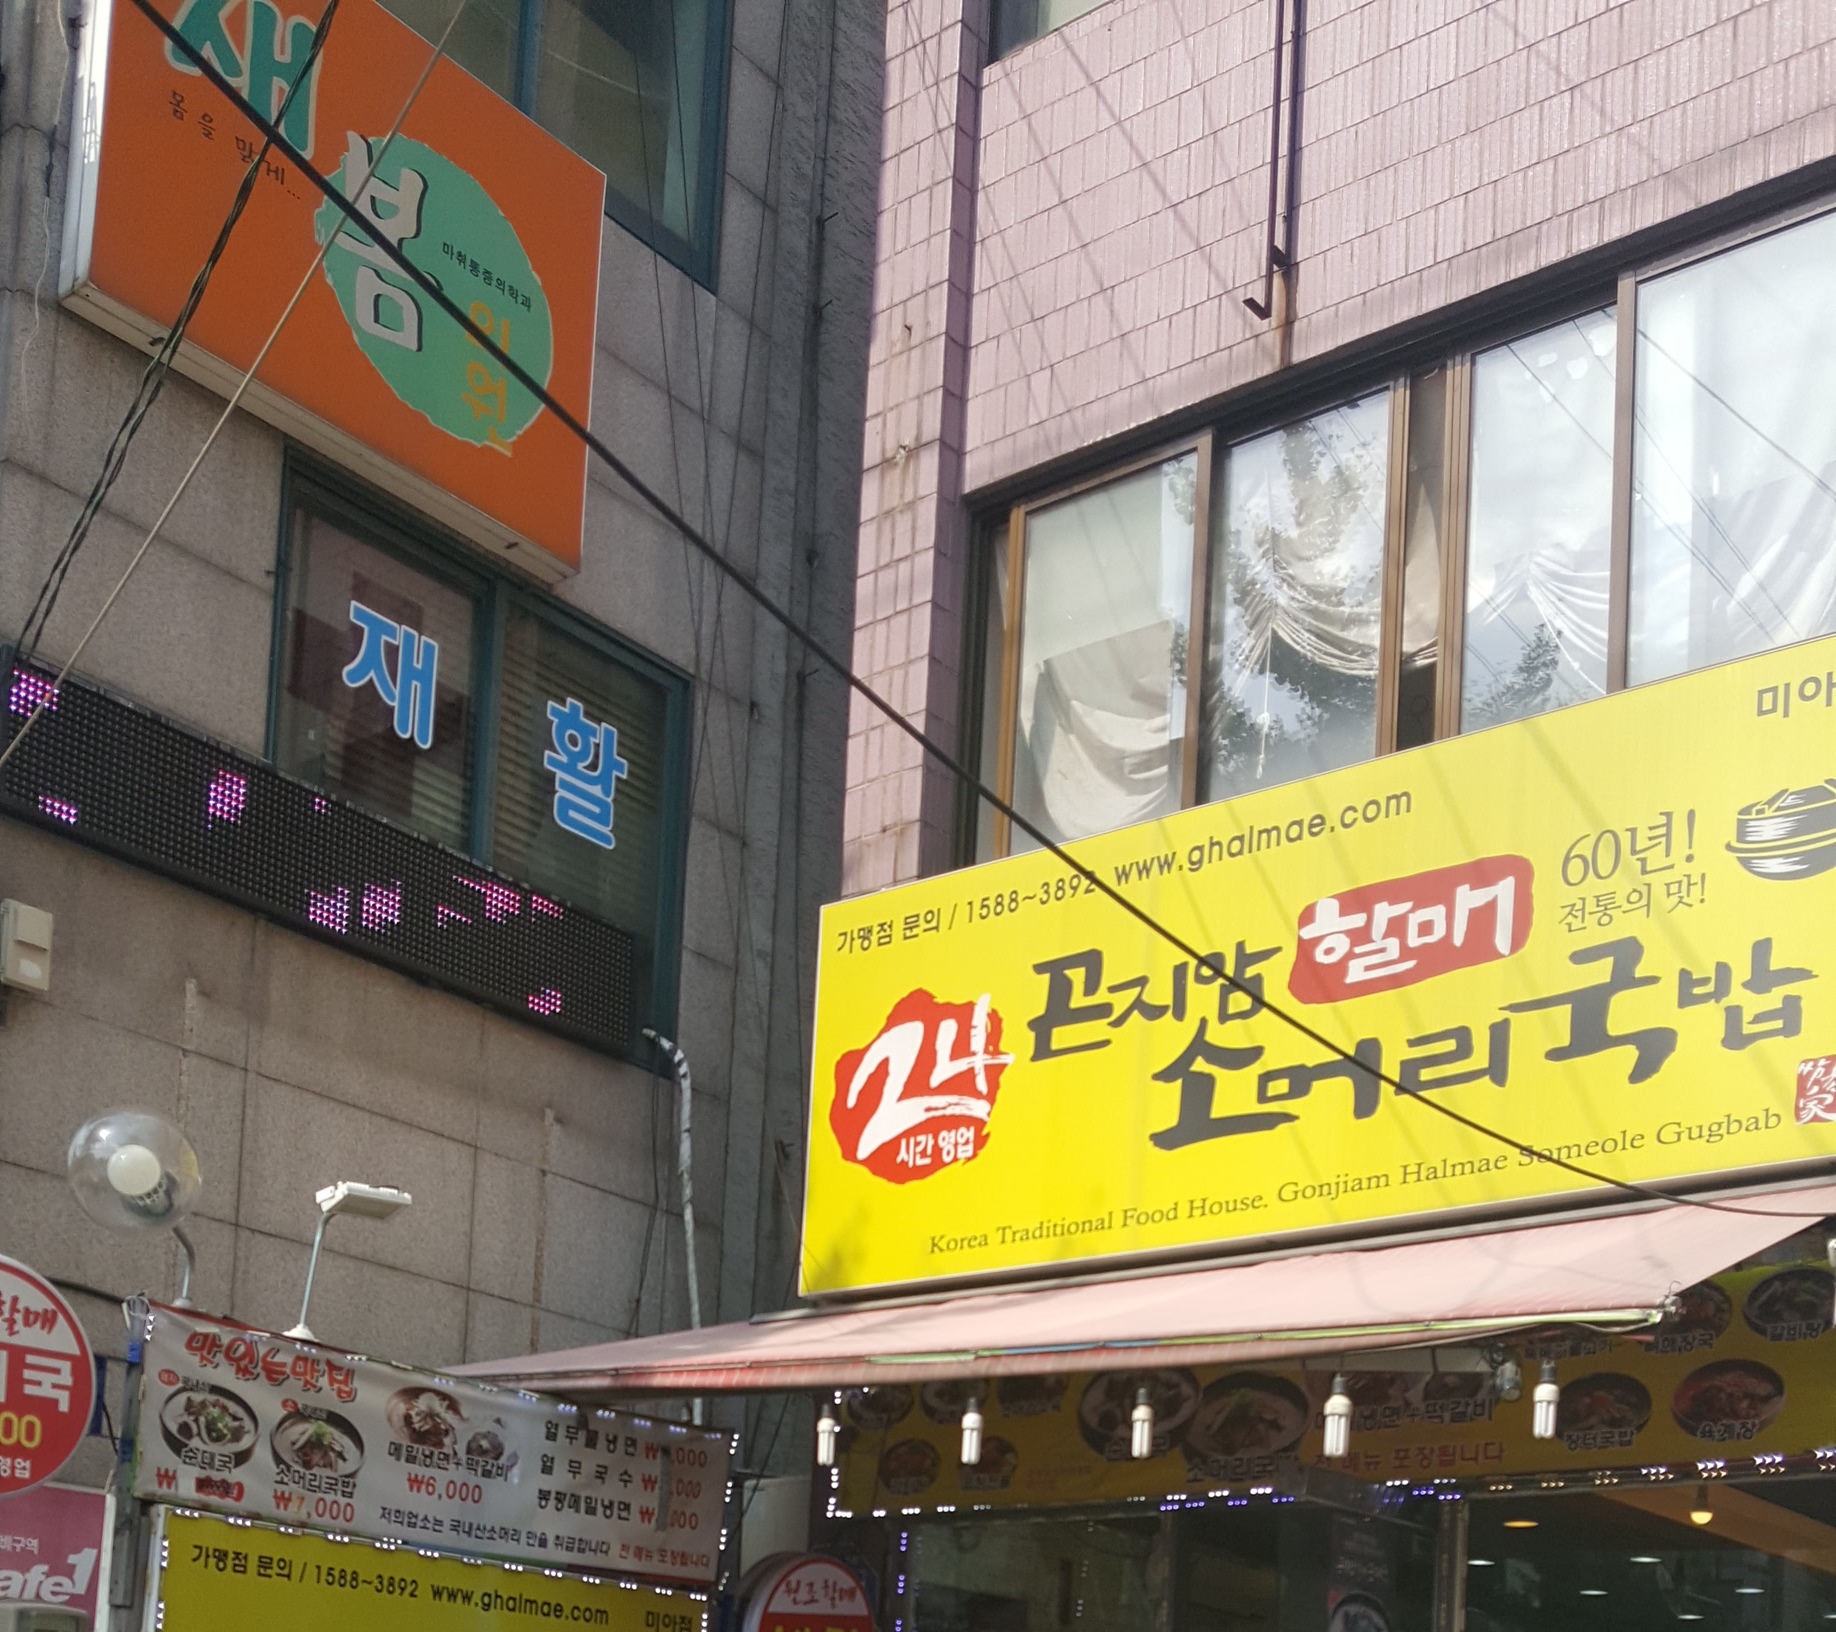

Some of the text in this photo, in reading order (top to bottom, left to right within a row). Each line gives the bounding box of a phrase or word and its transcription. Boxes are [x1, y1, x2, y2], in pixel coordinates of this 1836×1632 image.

[442, 241, 532, 312] 마취통증의학과
[837, 920, 895, 953] 가맹점
[902, 907, 941, 942] 문의
[1114, 790, 1412, 887] www.ghalmae.com
[1561, 809, 1697, 887] 60년!
[1558, 883, 1653, 934] 전통의
[1027, 876, 1516, 1062] 곤지암 할매
[1149, 936, 1820, 1151] 소머리국밥
[897, 1127, 975, 1168] 시간 영업
[929, 1108, 1783, 1256] Korea Traditional Food House. Gonjiam Halmae Someole Gugbab
[273, 1467, 356, 1500] 소머리국밥
[406, 1472, 484, 1505] ₩6,000
[191, 1544, 249, 1575] 가맹점
[256, 1554, 293, 1582] 문의
[430, 1582, 610, 1626] www.ghalmae.com
